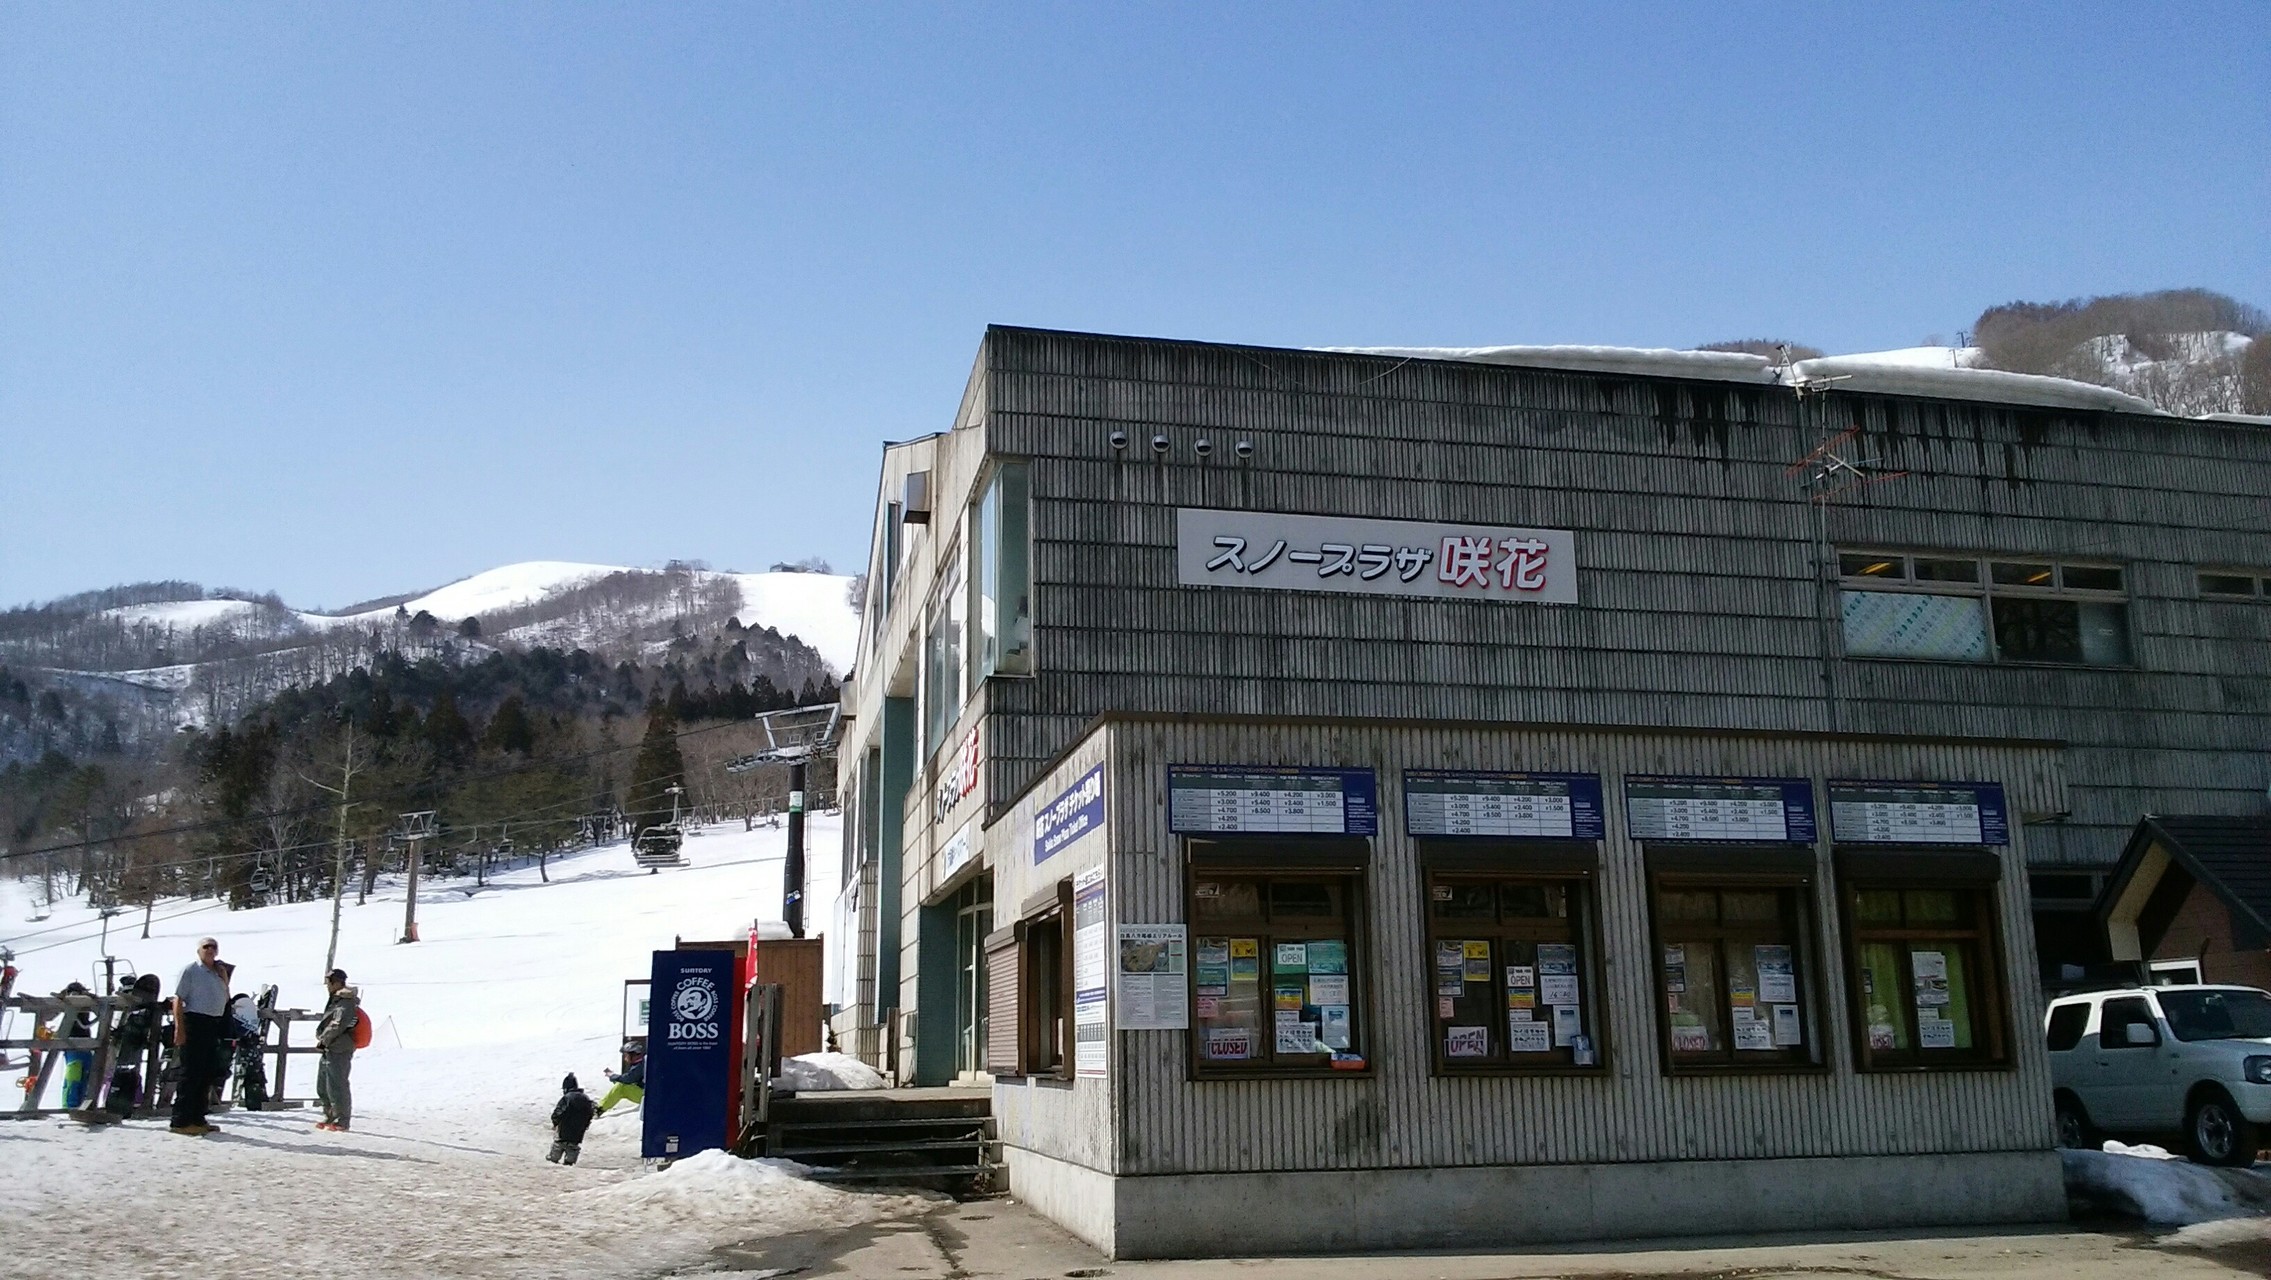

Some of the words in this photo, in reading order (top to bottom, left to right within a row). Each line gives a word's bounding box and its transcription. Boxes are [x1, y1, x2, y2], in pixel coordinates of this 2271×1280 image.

[1282, 953, 1303, 963] OPEN
[676, 977, 715, 990] COFFEE
[1510, 975, 1530, 985] OPEN
[668, 1022, 718, 1039] BOSS
[1211, 1038, 1247, 1055] CLOSED
